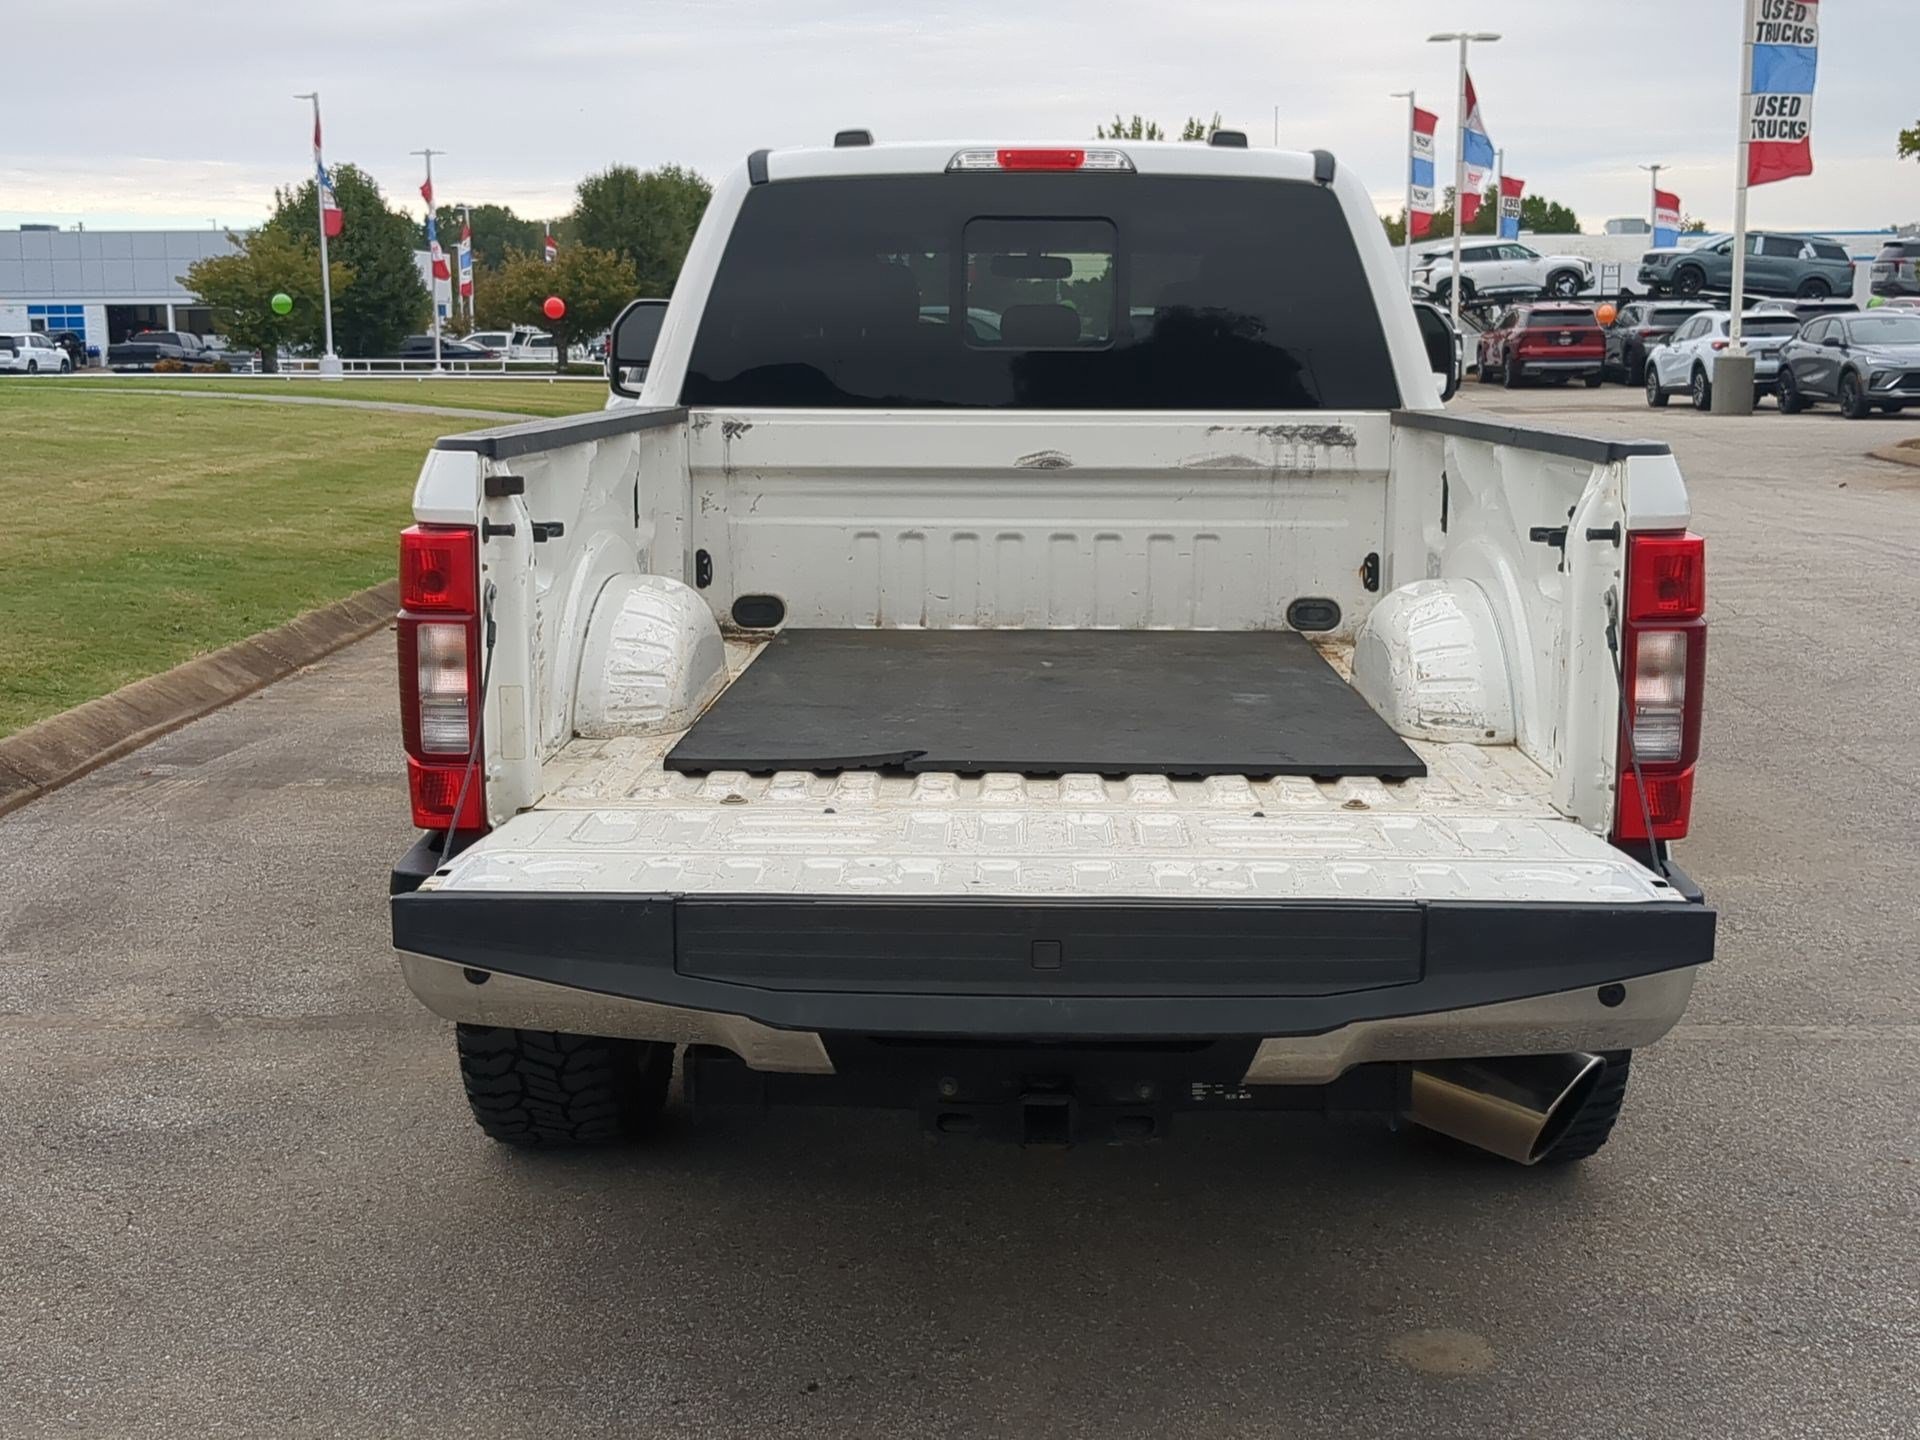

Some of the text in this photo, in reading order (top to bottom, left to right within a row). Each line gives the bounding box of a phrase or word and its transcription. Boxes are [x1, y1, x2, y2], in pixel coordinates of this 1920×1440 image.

[1762, 0, 1807, 22] USED
[1756, 22, 1814, 44] TRUCKS
[1755, 96, 1801, 117] USED
[1751, 119, 1807, 139] TRUCKS
